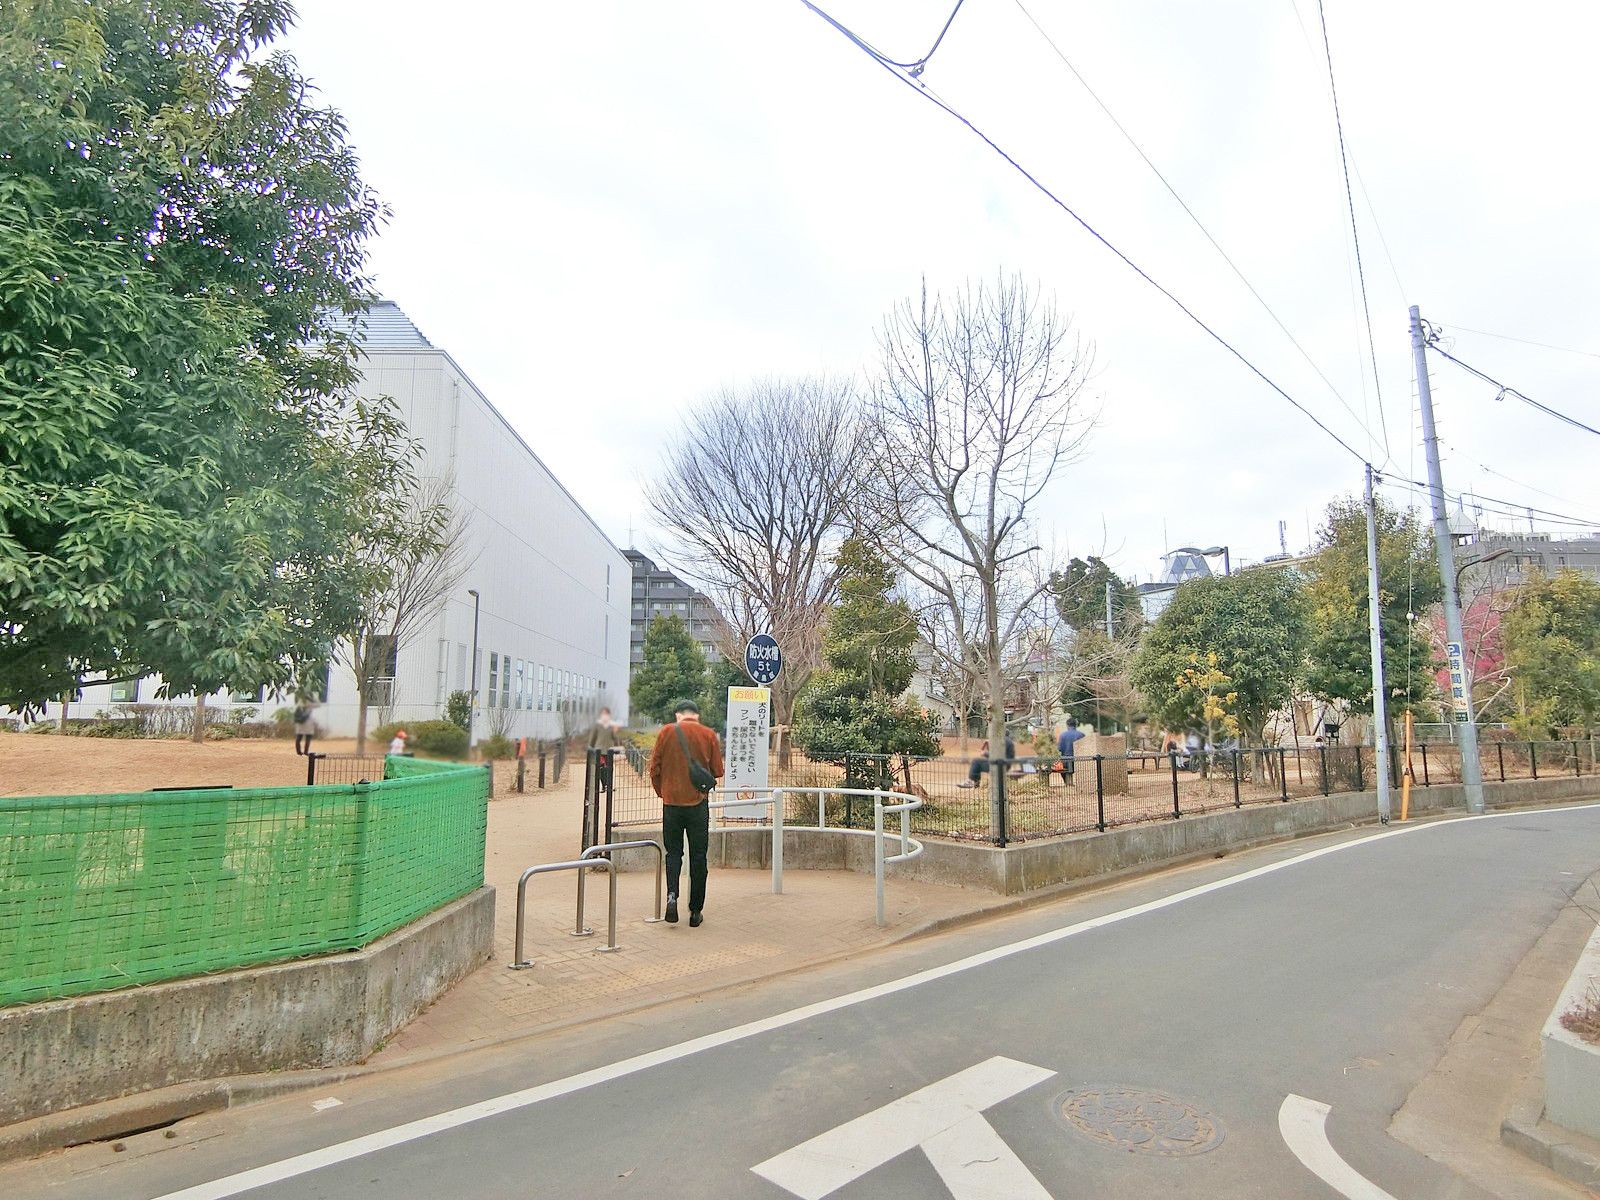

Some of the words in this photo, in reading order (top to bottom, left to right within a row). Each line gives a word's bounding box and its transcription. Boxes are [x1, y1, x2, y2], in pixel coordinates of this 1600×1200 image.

[749, 644, 779, 661] 防火水槽
[735, 689, 764, 700] お願い
[758, 702, 767, 737] 犬のリードを
[730, 726, 739, 780] きちんとしましょう
